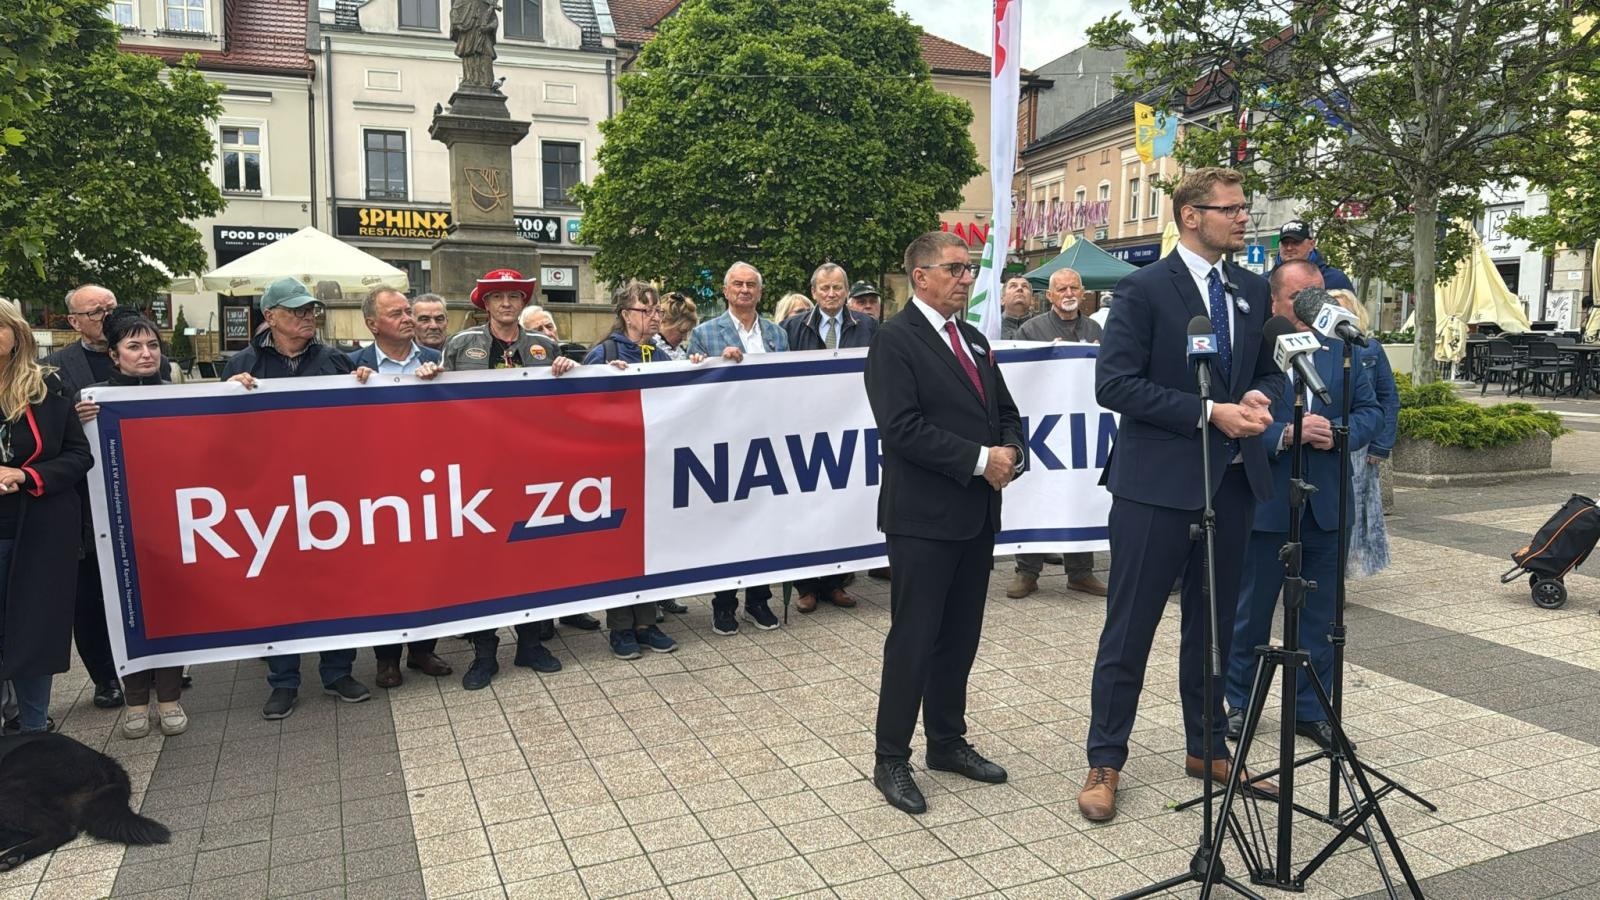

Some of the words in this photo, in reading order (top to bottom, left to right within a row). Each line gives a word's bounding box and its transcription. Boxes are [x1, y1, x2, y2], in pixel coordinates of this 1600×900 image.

[359, 208, 449, 229] SPHINX
[220, 230, 255, 239] FOOD
[359, 227, 449, 239] RESTAURACJA
[112, 467, 120, 479] KW
[113, 480, 122, 514] Kandydata
[175, 463, 496, 579] Rybnik
[525, 476, 612, 528] za
[119, 525, 127, 558] Prezydenta
[124, 568, 132, 588] Karola
[126, 589, 135, 628] Nawrockiego
